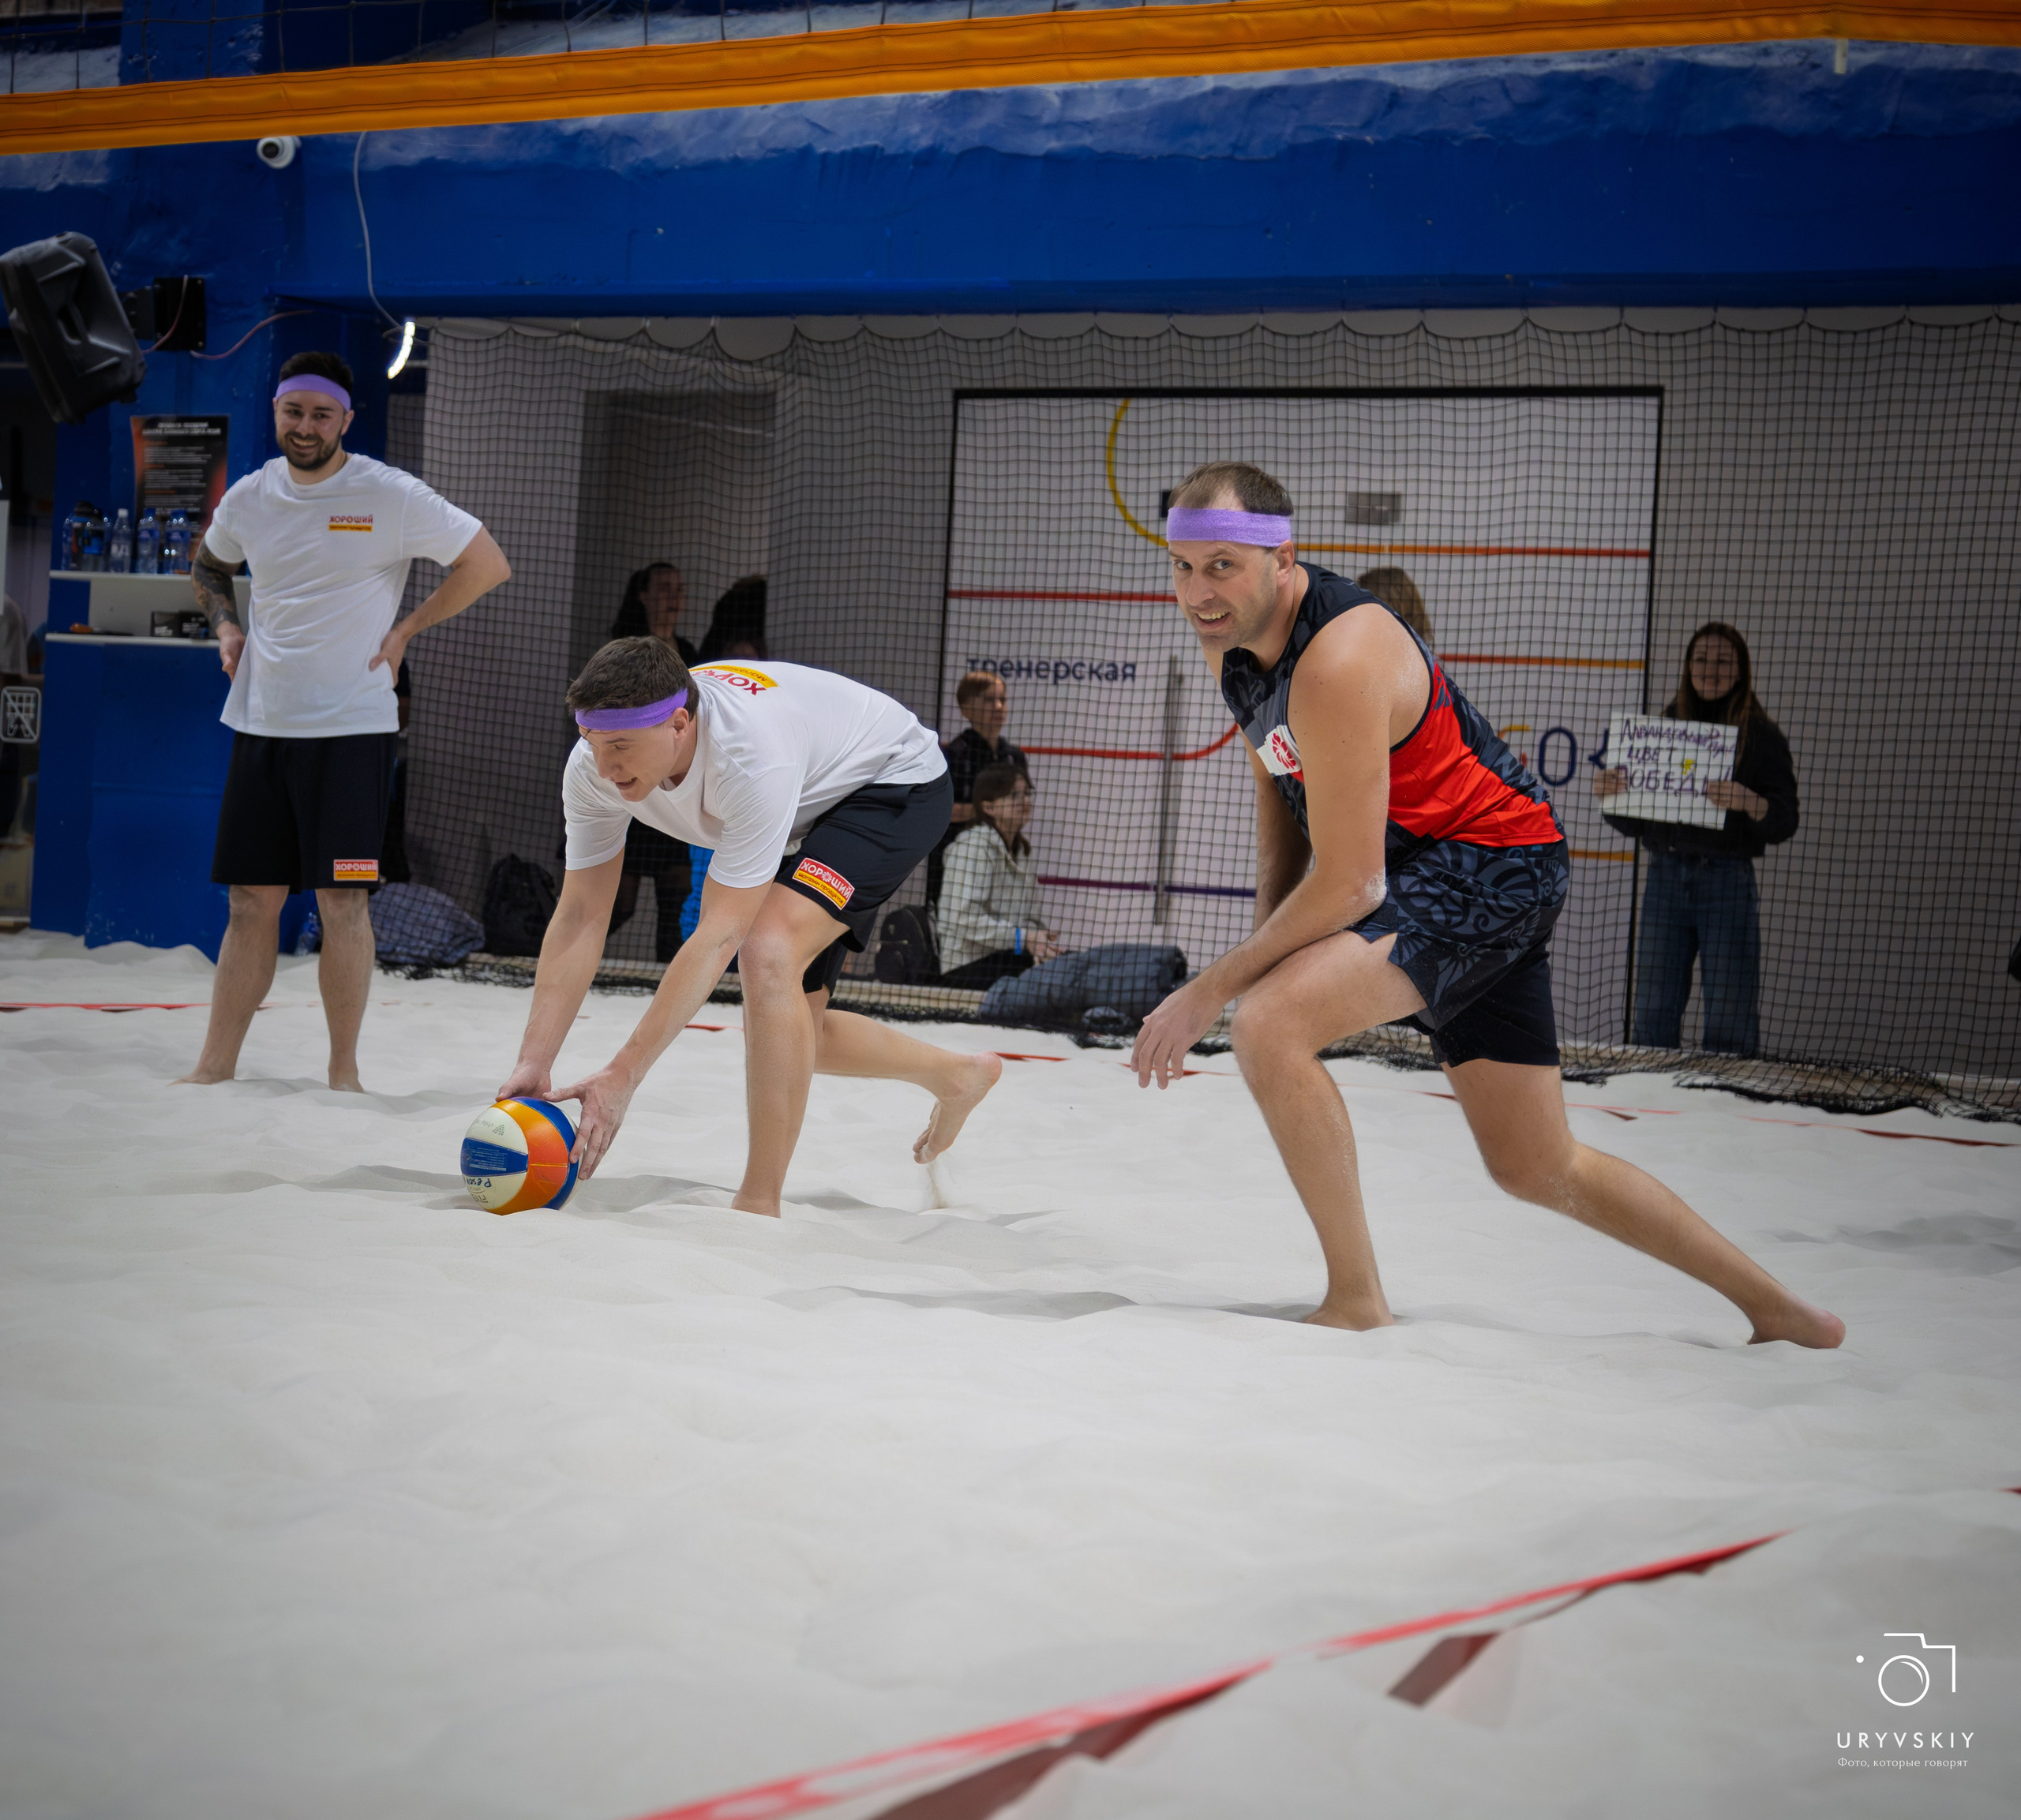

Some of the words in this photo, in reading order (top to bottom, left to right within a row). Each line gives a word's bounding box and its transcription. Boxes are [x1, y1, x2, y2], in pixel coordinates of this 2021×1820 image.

[329, 514, 373, 523] ХОРОШИЙ
[336, 861, 377, 871] ХОРОШИЙ
[798, 872, 820, 886] магазин
[801, 862, 853, 898] ХОРОШИЙ
